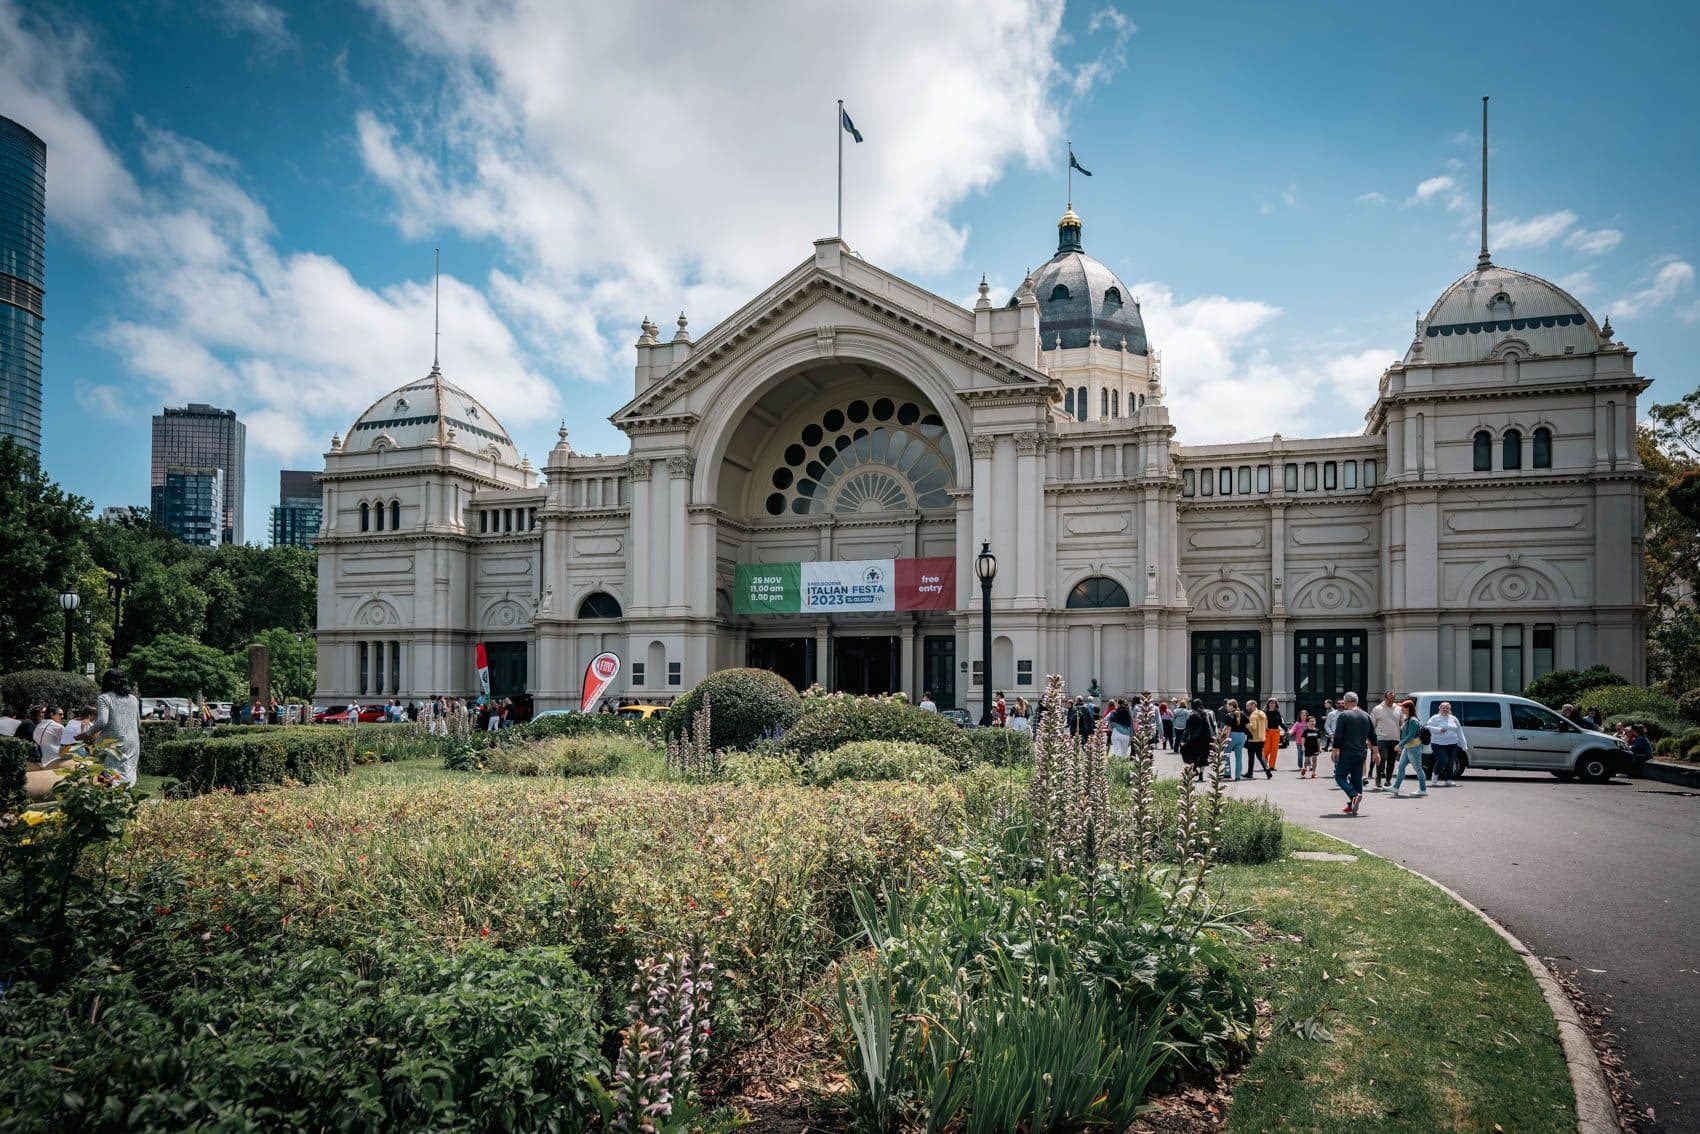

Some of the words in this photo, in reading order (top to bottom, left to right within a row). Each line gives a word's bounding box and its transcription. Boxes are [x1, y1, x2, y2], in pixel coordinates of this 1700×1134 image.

[808, 586, 848, 594] ITALIAN
[852, 585, 884, 594] FESTA
[918, 584, 942, 594] entry
[769, 594, 784, 602] pm
[811, 595, 844, 605] 2023
[600, 660, 614, 672] FIAT
